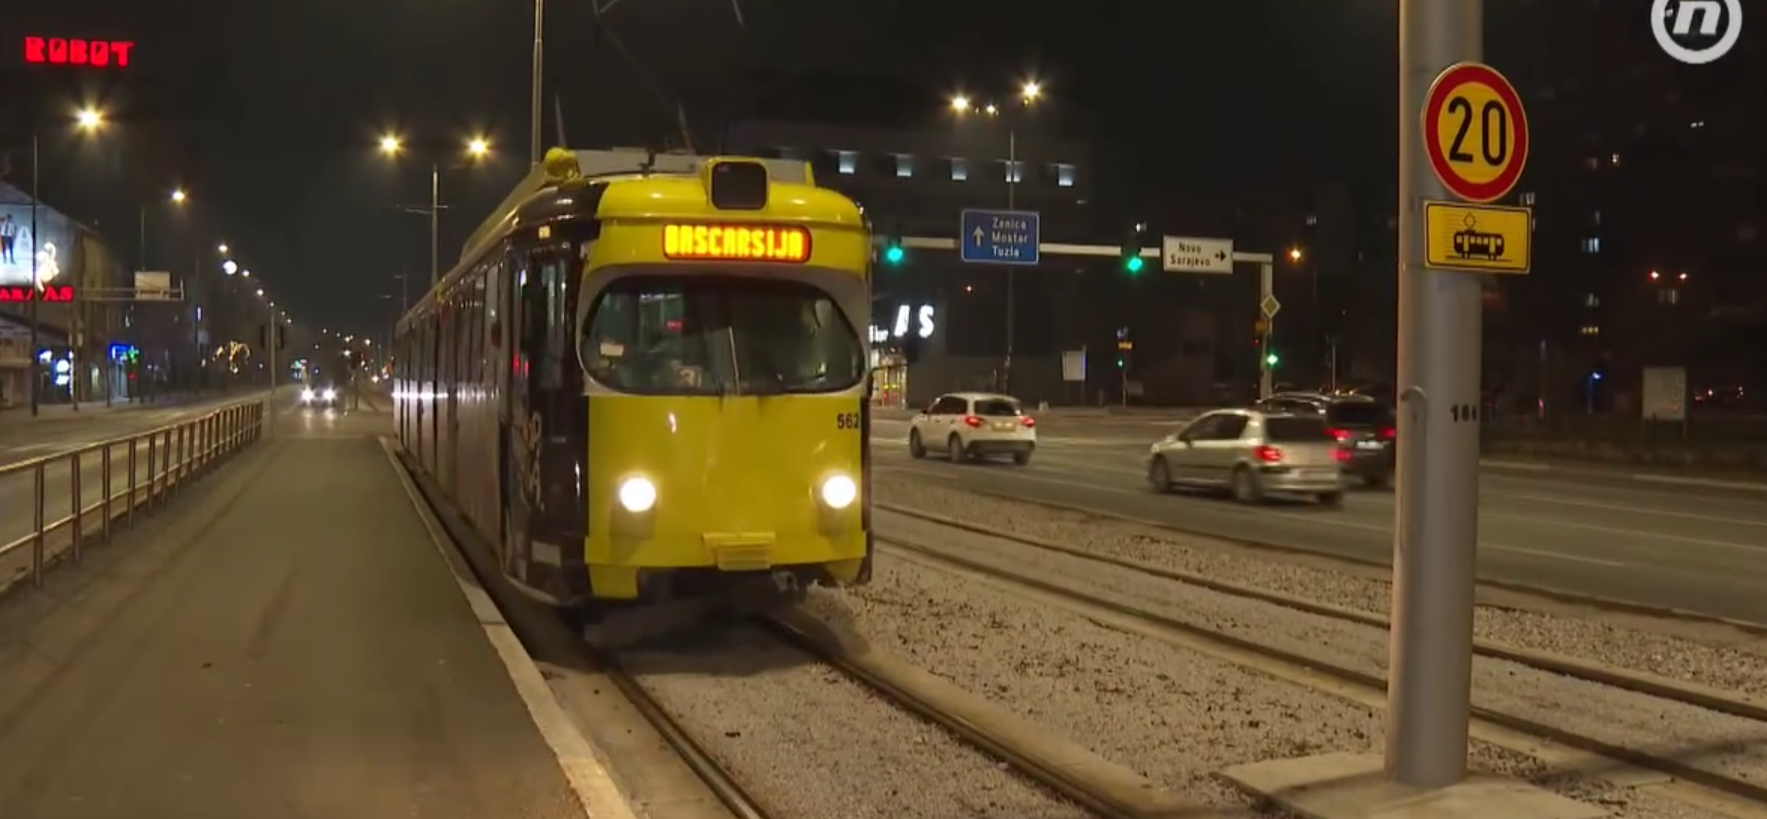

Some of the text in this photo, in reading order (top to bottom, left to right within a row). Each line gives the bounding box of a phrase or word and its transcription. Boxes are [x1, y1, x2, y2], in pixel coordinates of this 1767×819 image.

[25, 36, 135, 67] ROBOT
[1448, 96, 1508, 166] 20
[992, 217, 1027, 230] Zenica
[992, 231, 1028, 243] Mostar
[992, 245, 1020, 258] Tuzla
[1179, 242, 1203, 254] Novo
[1170, 254, 1212, 268] Sarajevo
[836, 413, 859, 431] 562
